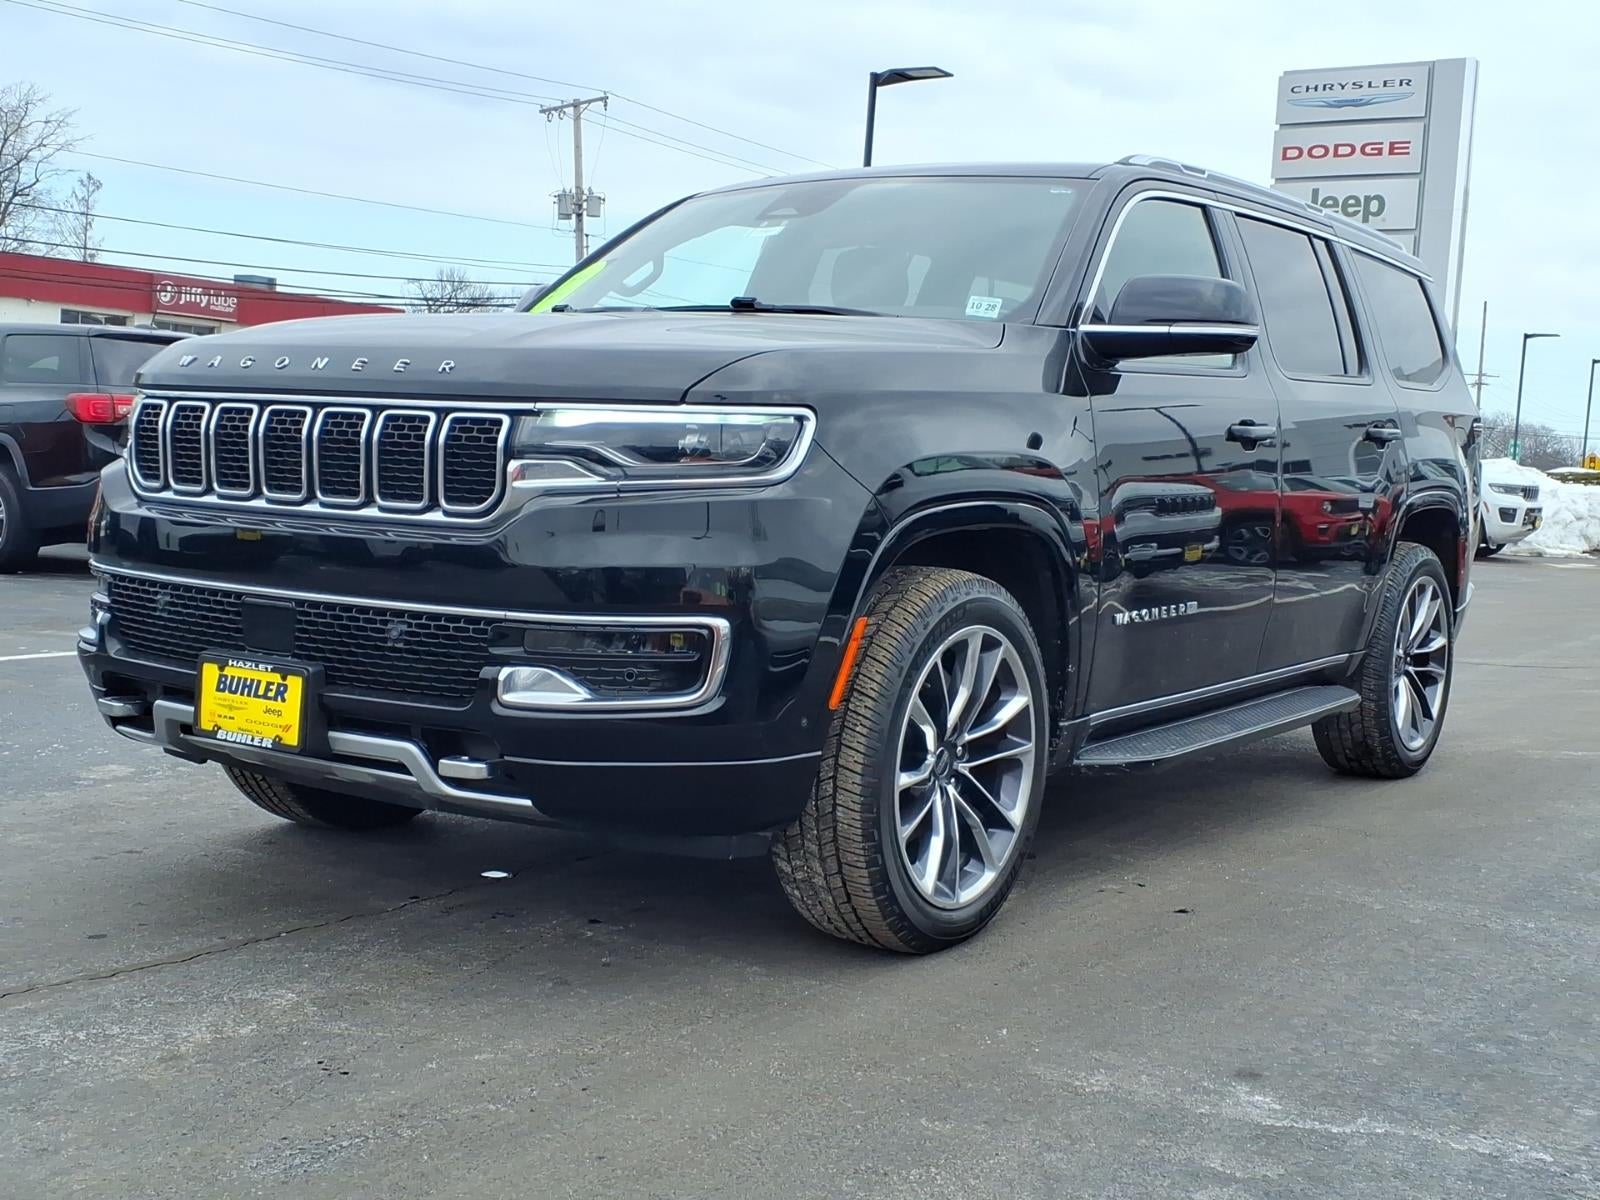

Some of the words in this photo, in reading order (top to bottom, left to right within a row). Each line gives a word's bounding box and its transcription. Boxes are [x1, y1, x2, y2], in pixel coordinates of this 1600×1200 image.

[1290, 78, 1413, 94] CHRYSLER
[1281, 140, 1412, 161] DODGE
[179, 286, 208, 307] jiffy
[210, 289, 237, 308] lube
[970, 302, 982, 310] 10
[985, 303, 997, 312] 28
[179, 355, 456, 373] WAGONEER
[1114, 603, 1186, 625] WAGONEER
[228, 659, 274, 672] HAZLET
[215, 672, 288, 703] BUHLER
[263, 705, 283, 718] Jeep
[216, 730, 273, 748] BUHLER
